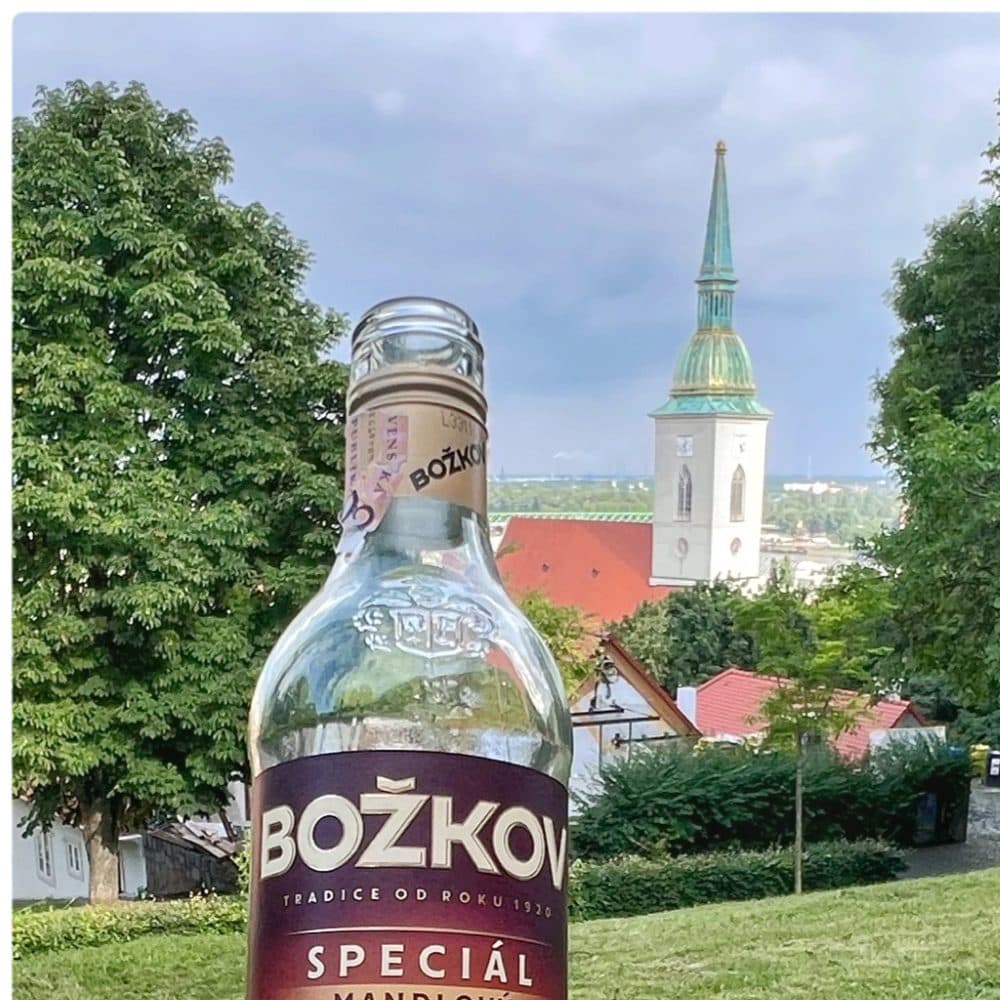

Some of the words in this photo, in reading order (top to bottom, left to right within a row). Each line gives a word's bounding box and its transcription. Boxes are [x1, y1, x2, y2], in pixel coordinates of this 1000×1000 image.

[261, 776, 567, 891] BOŽKOV
[284, 888, 380, 906] TRADICE
[395, 888, 427, 900] OD
[442, 890, 503, 907] ROKU
[513, 900, 552, 918] 1920
[307, 940, 533, 987] SPECIÁL
